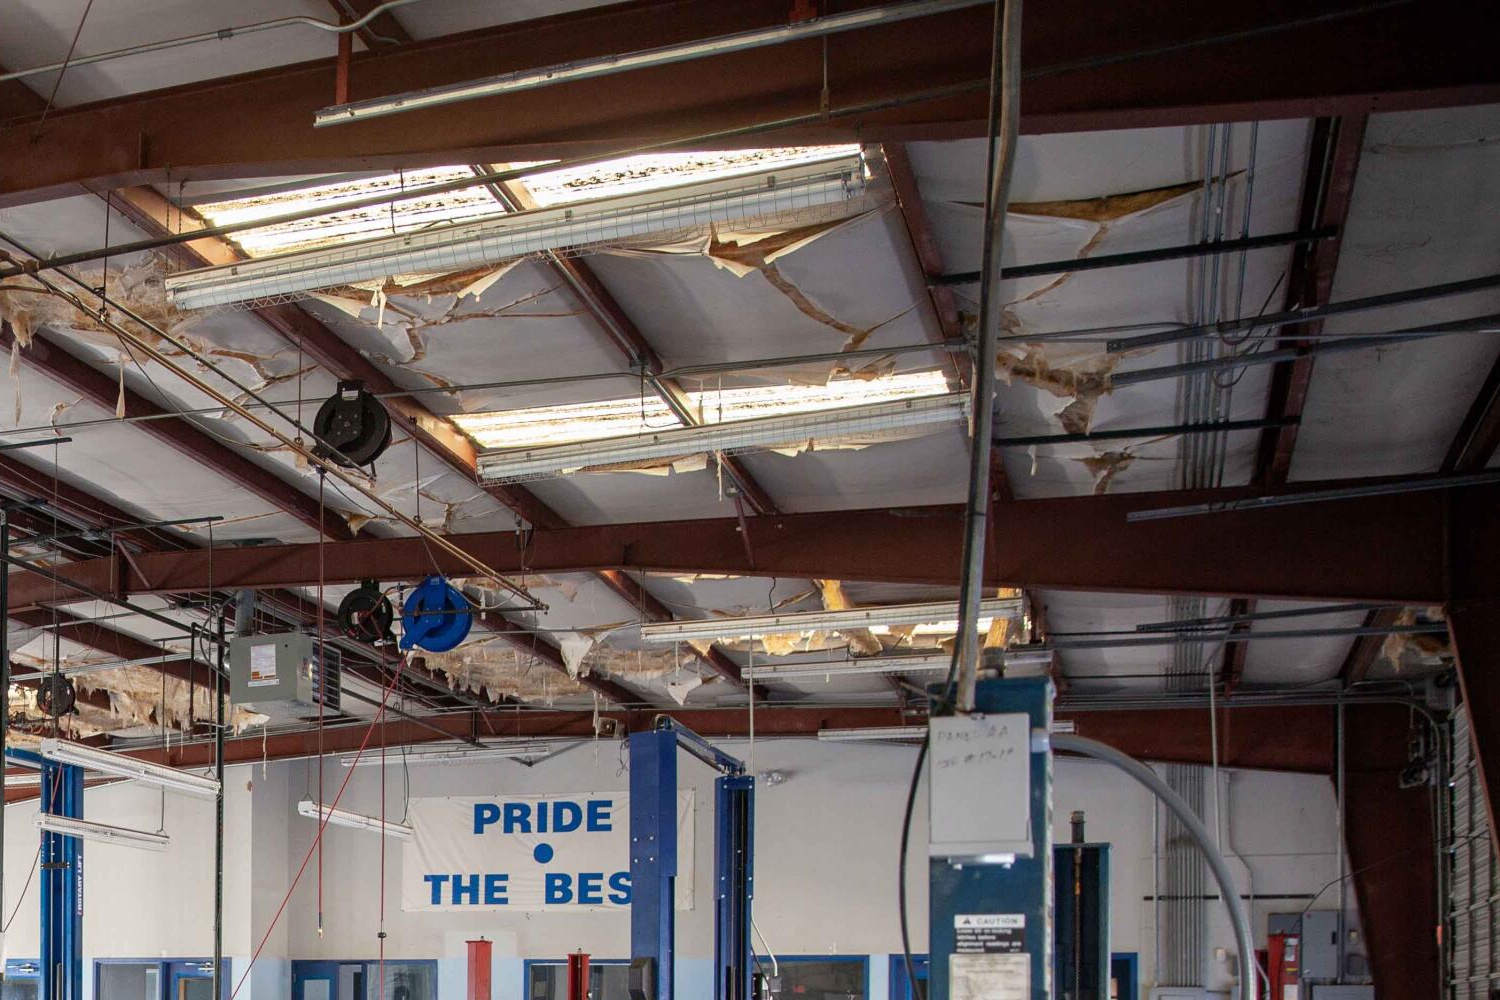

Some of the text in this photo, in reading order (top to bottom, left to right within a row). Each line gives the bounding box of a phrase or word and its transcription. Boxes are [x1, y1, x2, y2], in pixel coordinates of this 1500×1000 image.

[473, 800, 613, 834] PRIDE
[423, 871, 632, 905] THE BES
